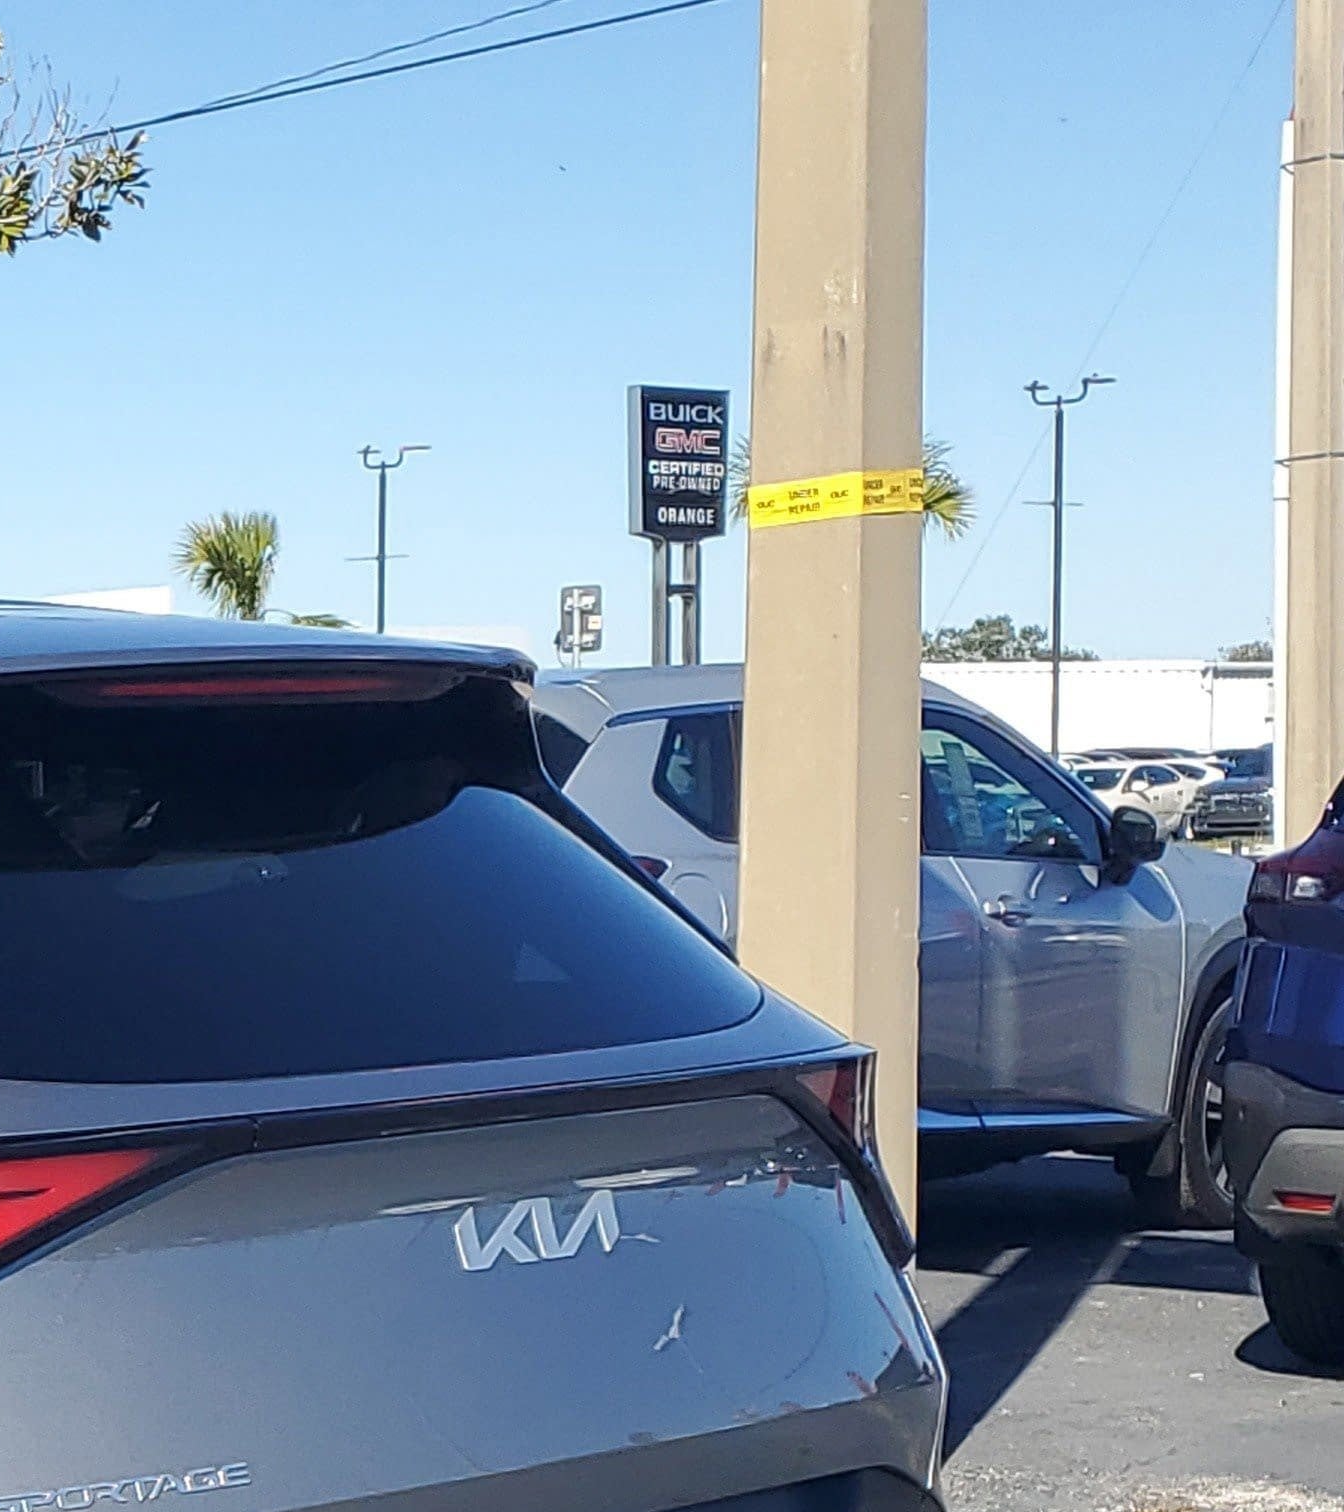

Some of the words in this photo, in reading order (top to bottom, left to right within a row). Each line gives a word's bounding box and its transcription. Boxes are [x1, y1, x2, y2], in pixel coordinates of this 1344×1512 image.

[649, 402, 723, 424] BUICK
[656, 427, 720, 455] GMC
[649, 460, 724, 476] CERTIFIED
[653, 475, 720, 490] PRE-OWNED
[658, 506, 714, 524] ORANGE
[454, 1189, 620, 1272] KIA
